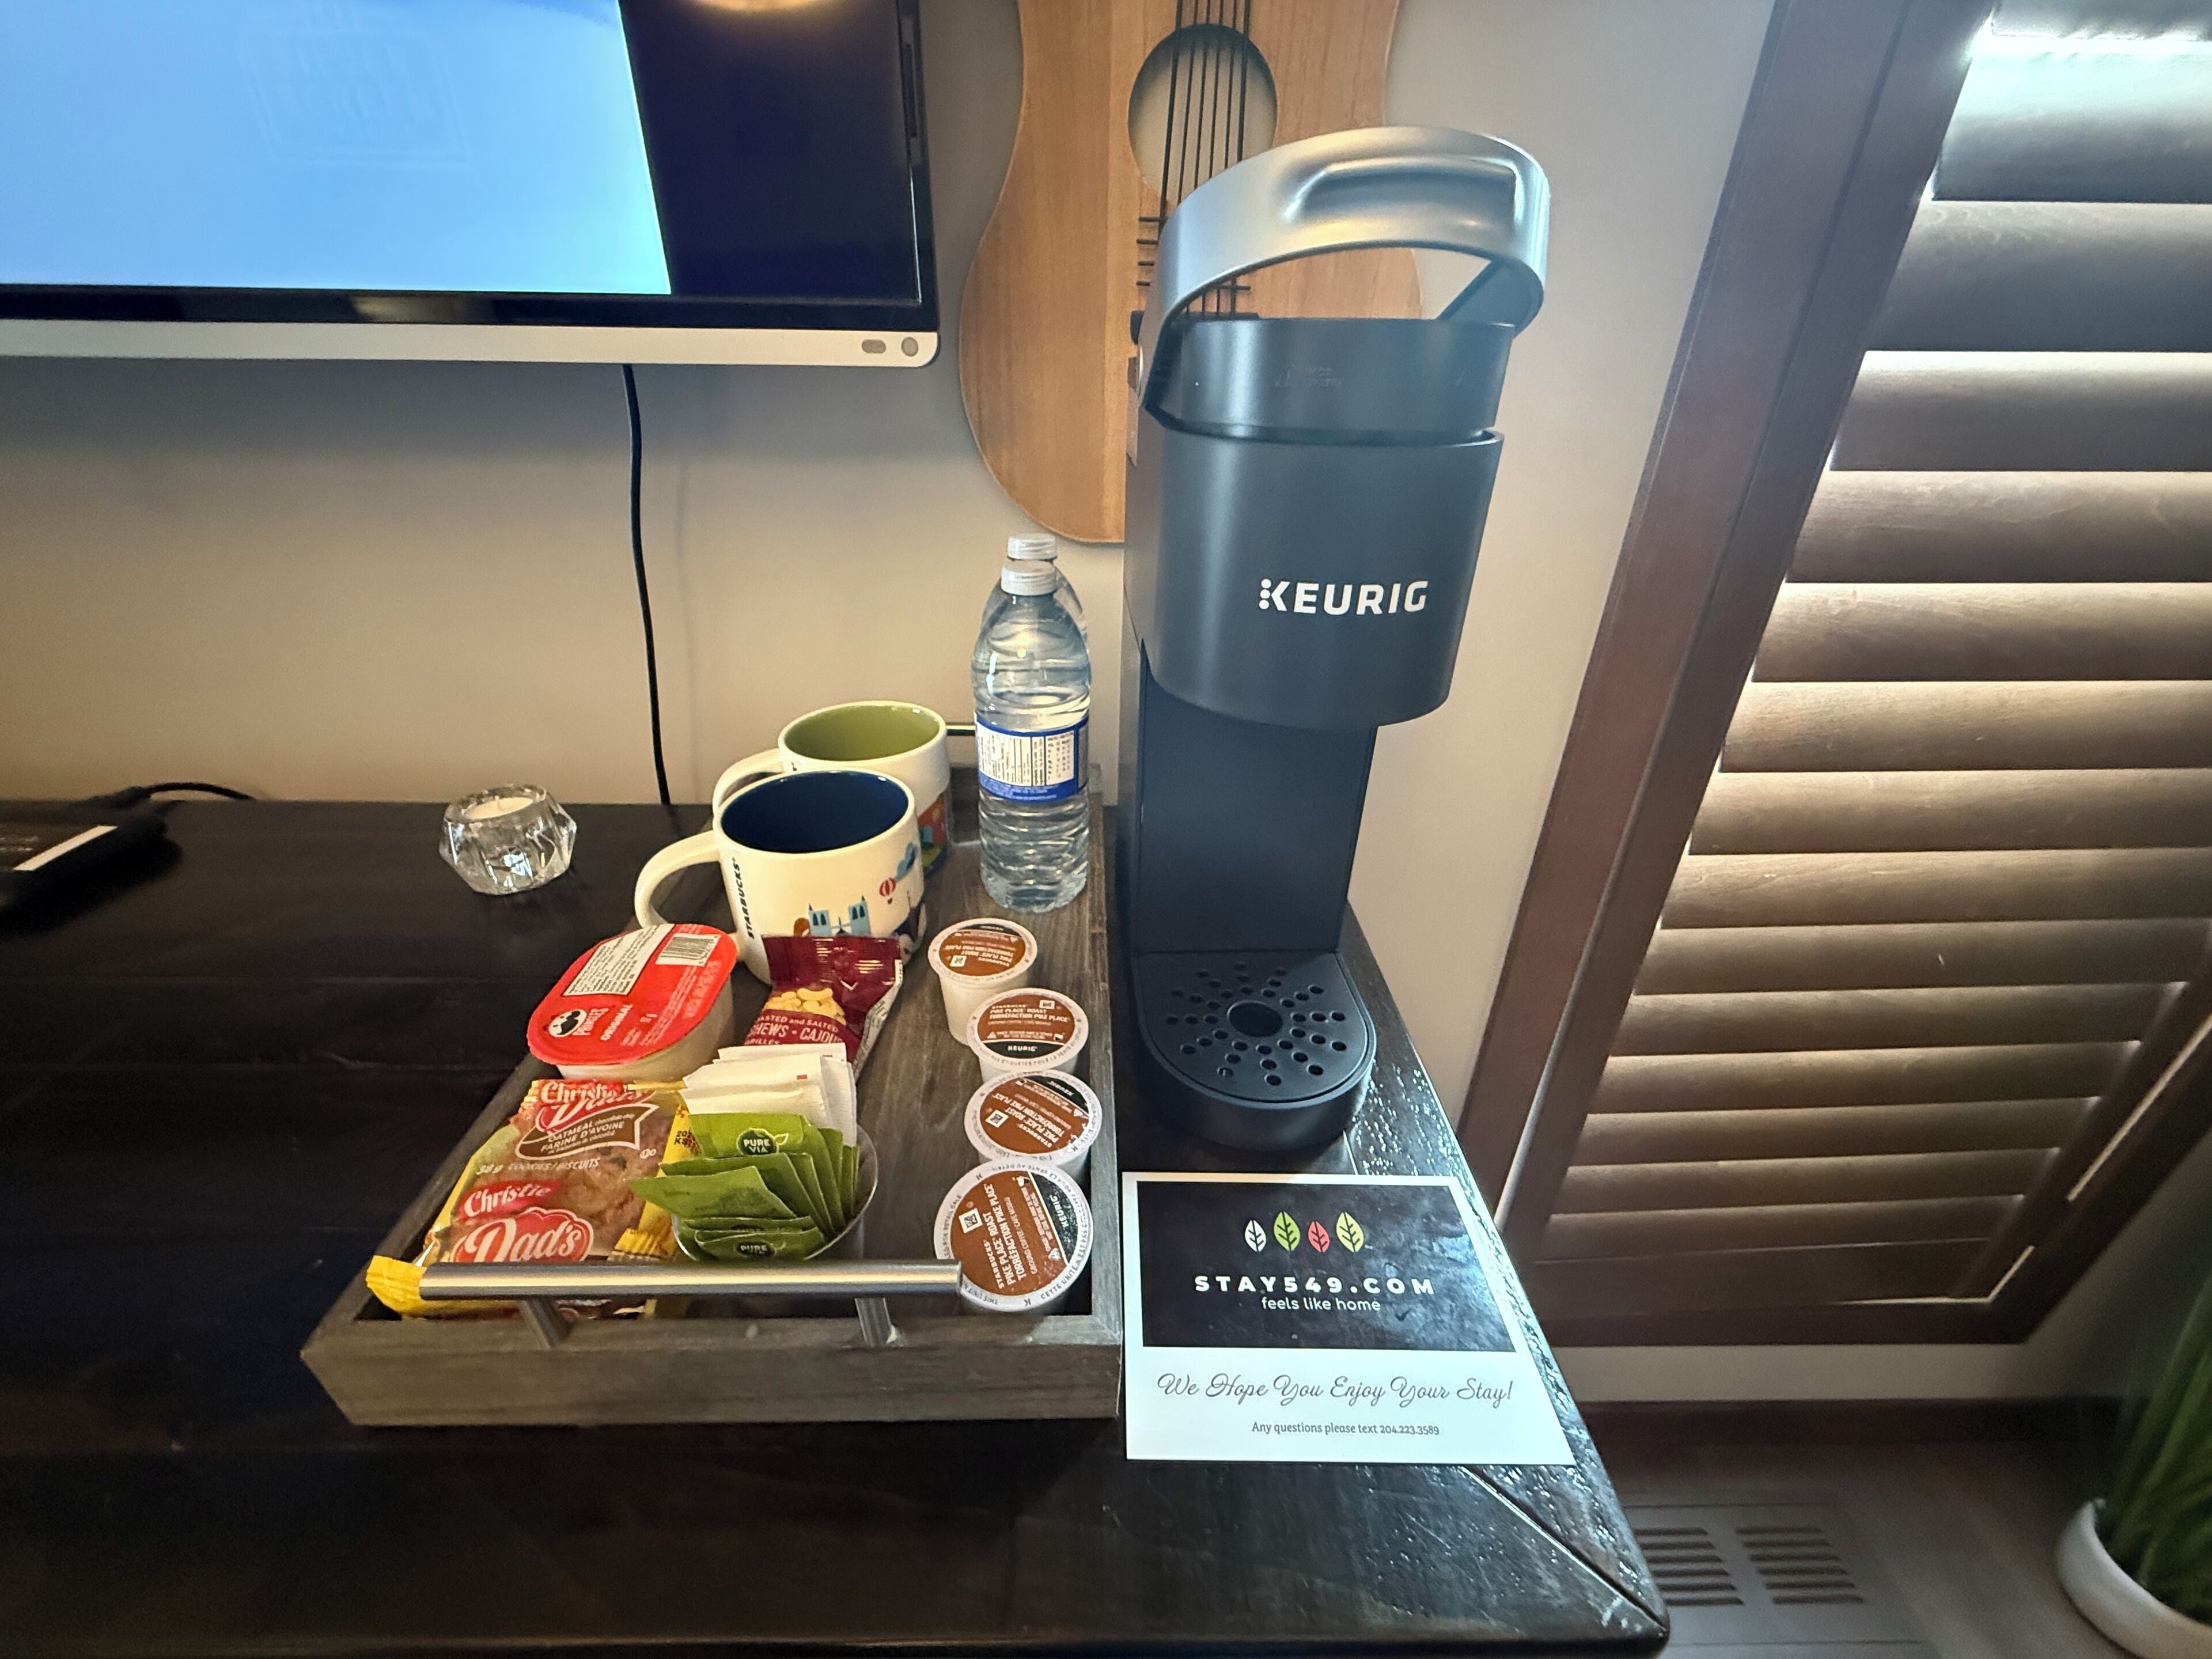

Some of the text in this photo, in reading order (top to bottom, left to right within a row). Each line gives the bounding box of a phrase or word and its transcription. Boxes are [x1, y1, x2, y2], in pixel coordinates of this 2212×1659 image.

[1259, 579, 1429, 615] KEURIG
[733, 862, 755, 939] STARBUCKS
[600, 1004, 633, 1040] ORIGINAL
[807, 1019, 839, 1033] SALTED
[540, 1134, 578, 1153] FARINE
[548, 1120, 593, 1143] OATMEAL
[744, 1138, 771, 1147] PURE
[748, 1146, 769, 1154] VIA
[464, 1183, 551, 1217] Christie
[1050, 1195, 1069, 1228] KEURIG
[464, 1217, 583, 1263] Dad's
[983, 1212, 1017, 1285] PIKE PLACE ROAST
[984, 1184, 1027, 1281] TORRÉFACTION PIKE PLACE
[983, 1241, 1005, 1289] STARBUCKS
[1040, 1285, 1062, 1300] CETTE
[1194, 1275, 1435, 1296] STAY549.COM
[1262, 1297, 1381, 1312] feels like home
[1157, 1373, 1514, 1409] We Hope You Enjoy Your Stay!
[1251, 1421, 1440, 1435] Any questions please text 204.223.3589
